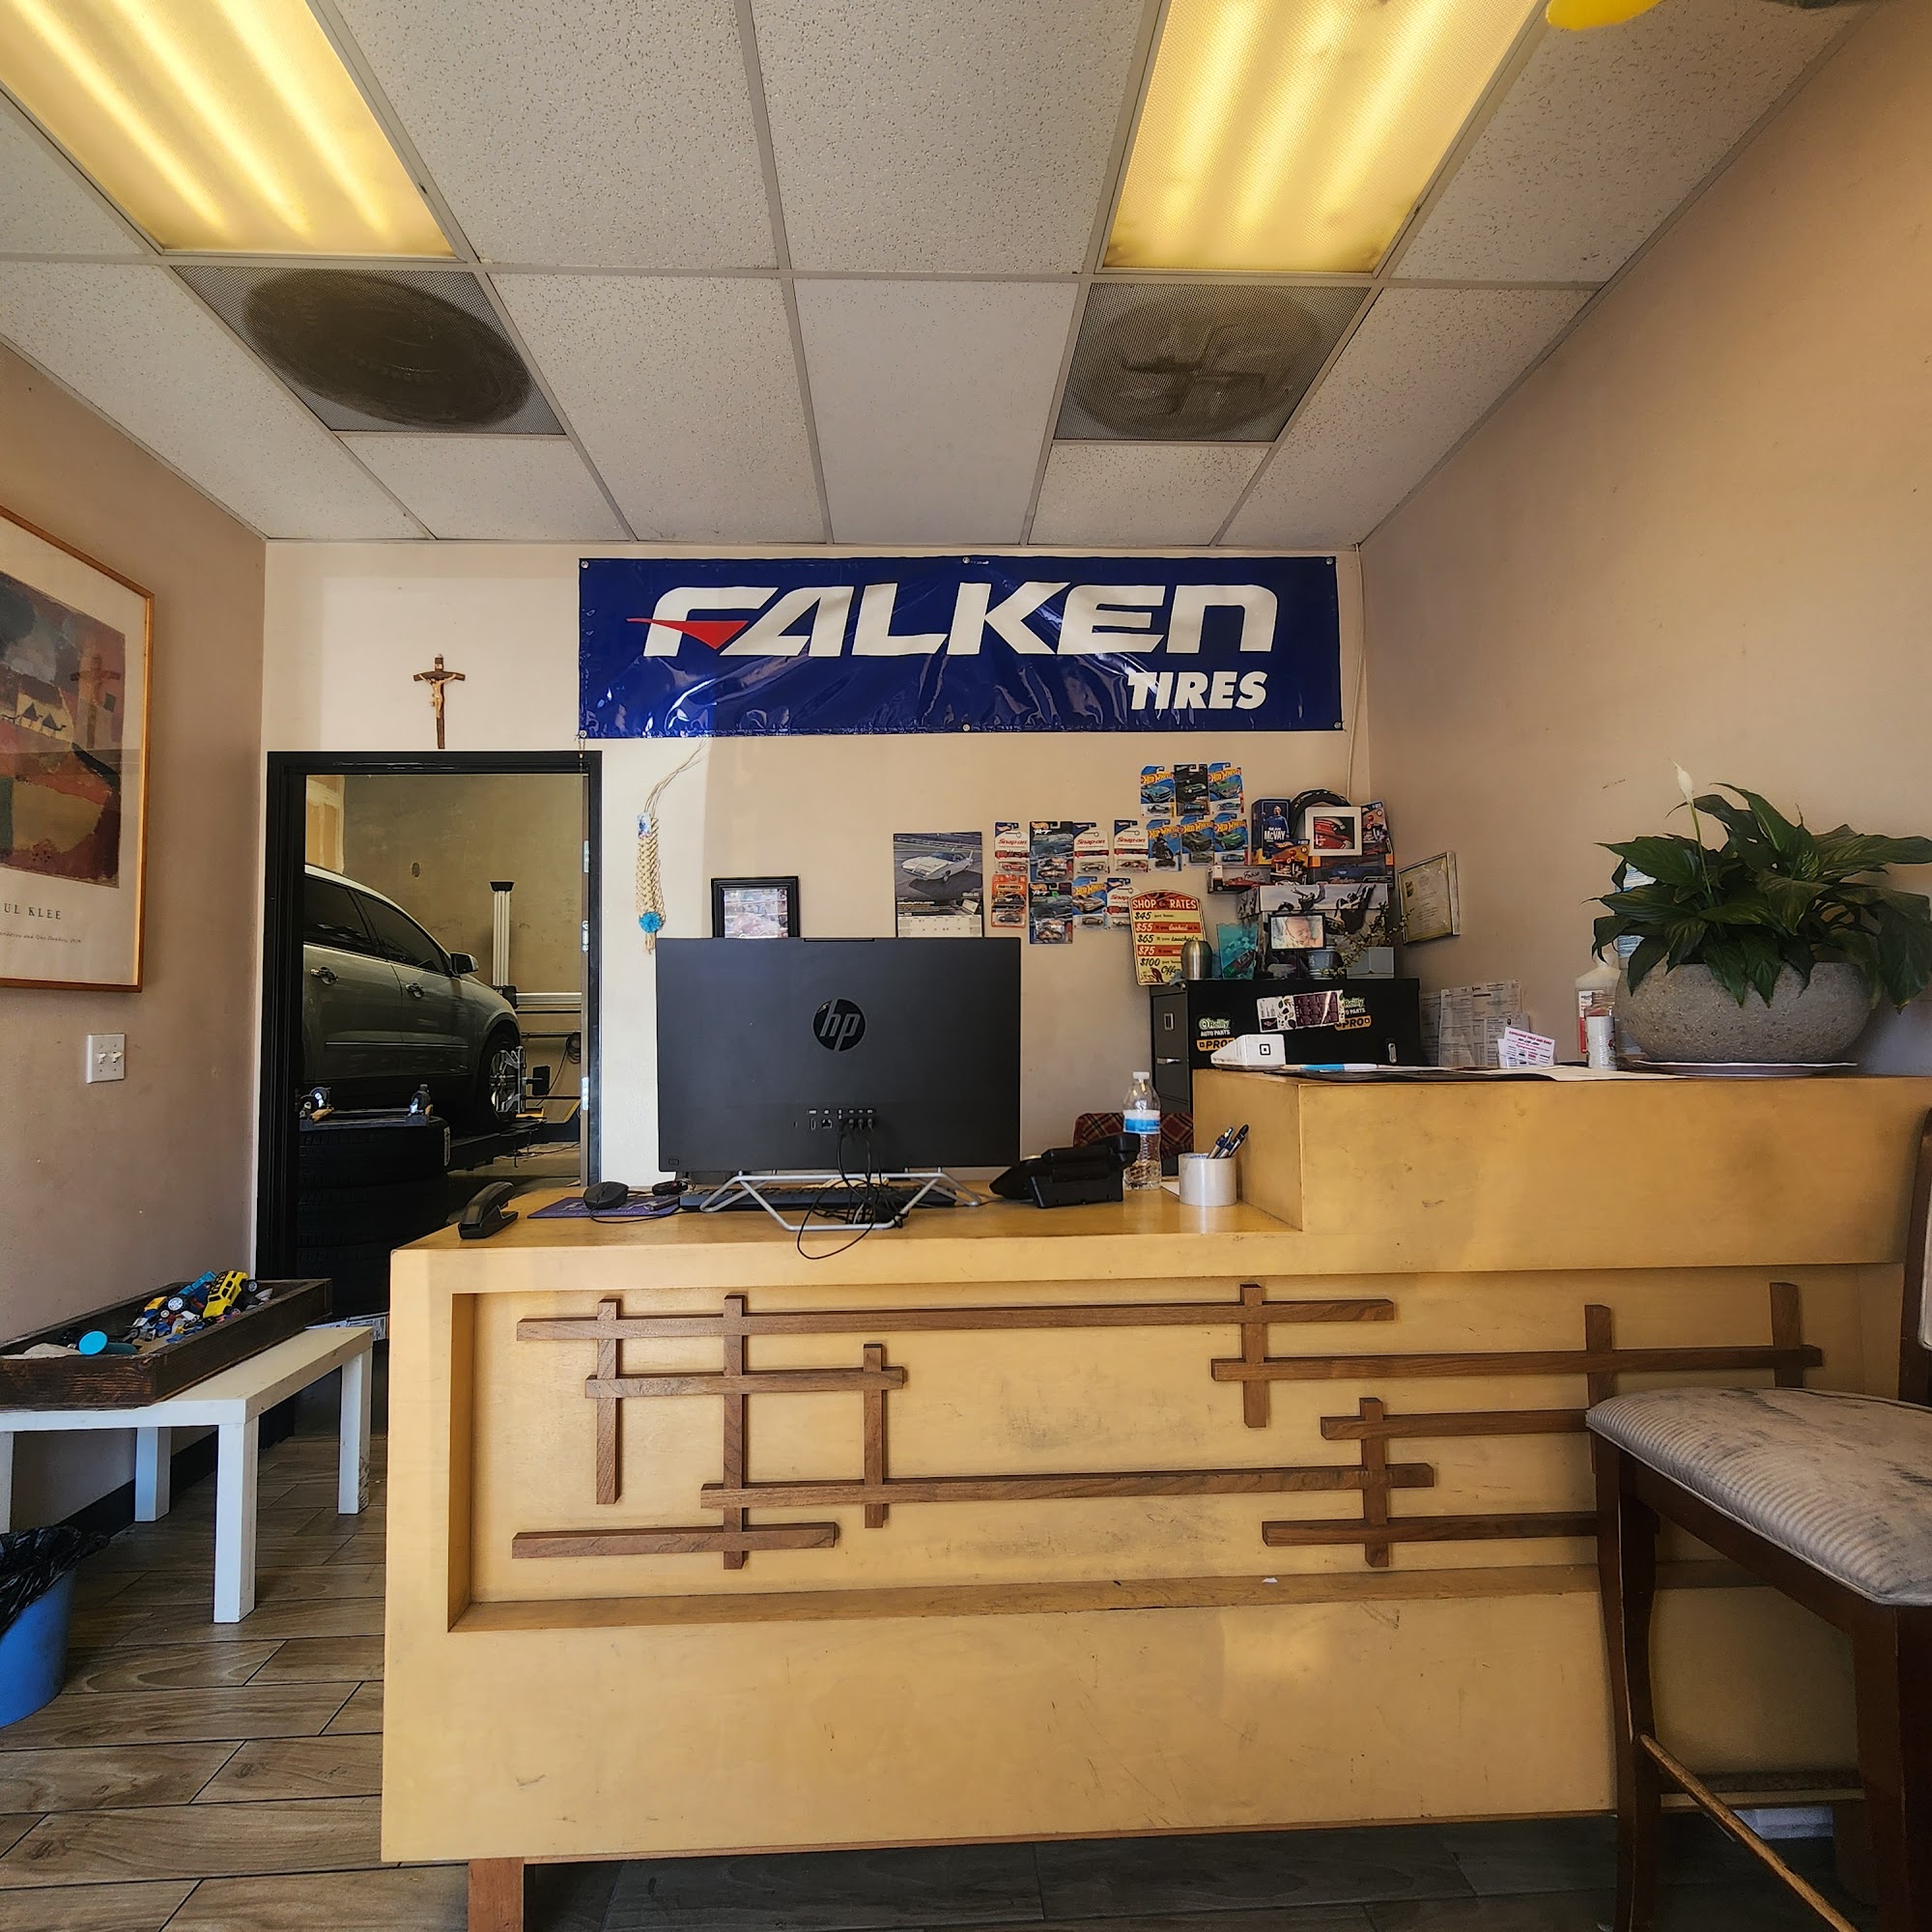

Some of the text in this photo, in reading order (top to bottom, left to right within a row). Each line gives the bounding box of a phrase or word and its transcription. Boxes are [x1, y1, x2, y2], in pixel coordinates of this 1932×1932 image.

[638, 582, 1278, 658] FALKEN
[1127, 670, 1268, 711] TIRES
[1132, 899, 1197, 909] SHOP RATES
[28, 906, 61, 920] KLEE
[1134, 912, 1151, 921] $45
[1136, 923, 1153, 932] $55
[1137, 934, 1154, 944] $65
[1138, 946, 1155, 955] $75
[1140, 957, 1161, 967] $100
[818, 998, 862, 1051] hp
[1342, 1018, 1364, 1028] PRO
[1206, 1039, 1228, 1049] PRO
